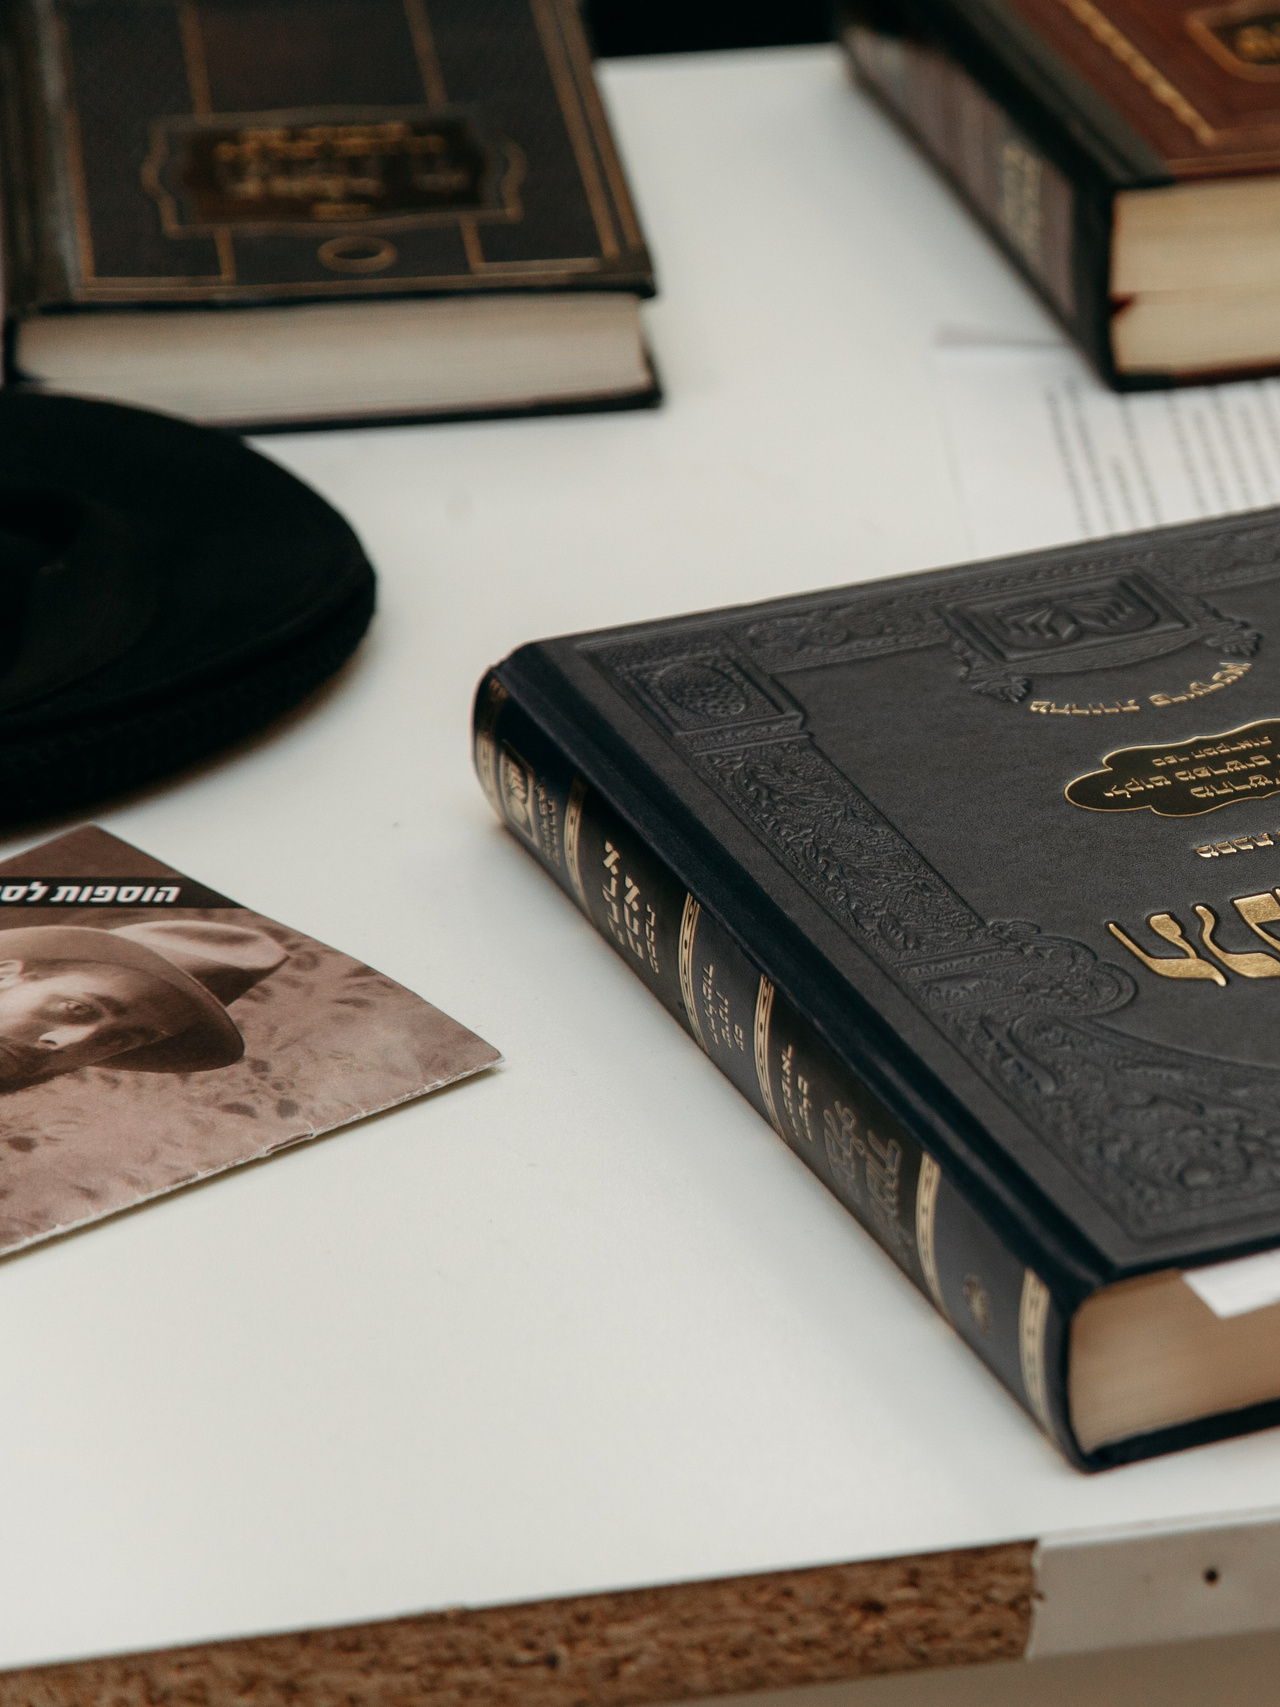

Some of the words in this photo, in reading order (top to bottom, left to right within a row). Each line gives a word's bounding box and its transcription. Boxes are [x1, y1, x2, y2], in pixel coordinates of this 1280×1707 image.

[1029, 699, 1141, 716] מהדורת
[1151, 755, 1190, 767] ספר
[1194, 735, 1272, 759] המקראות
[1103, 775, 1172, 799] ילקוט
[1174, 754, 1272, 781] מפרשים
[1198, 832, 1274, 858] מסכת
[0, 881, 50, 903] לס
[49, 885, 182, 903] הוספות
[602, 841, 626, 946] בתרא
[623, 875, 644, 960] בבא
[645, 904, 660, 974] מסכת
[733, 1023, 745, 1052] עם
